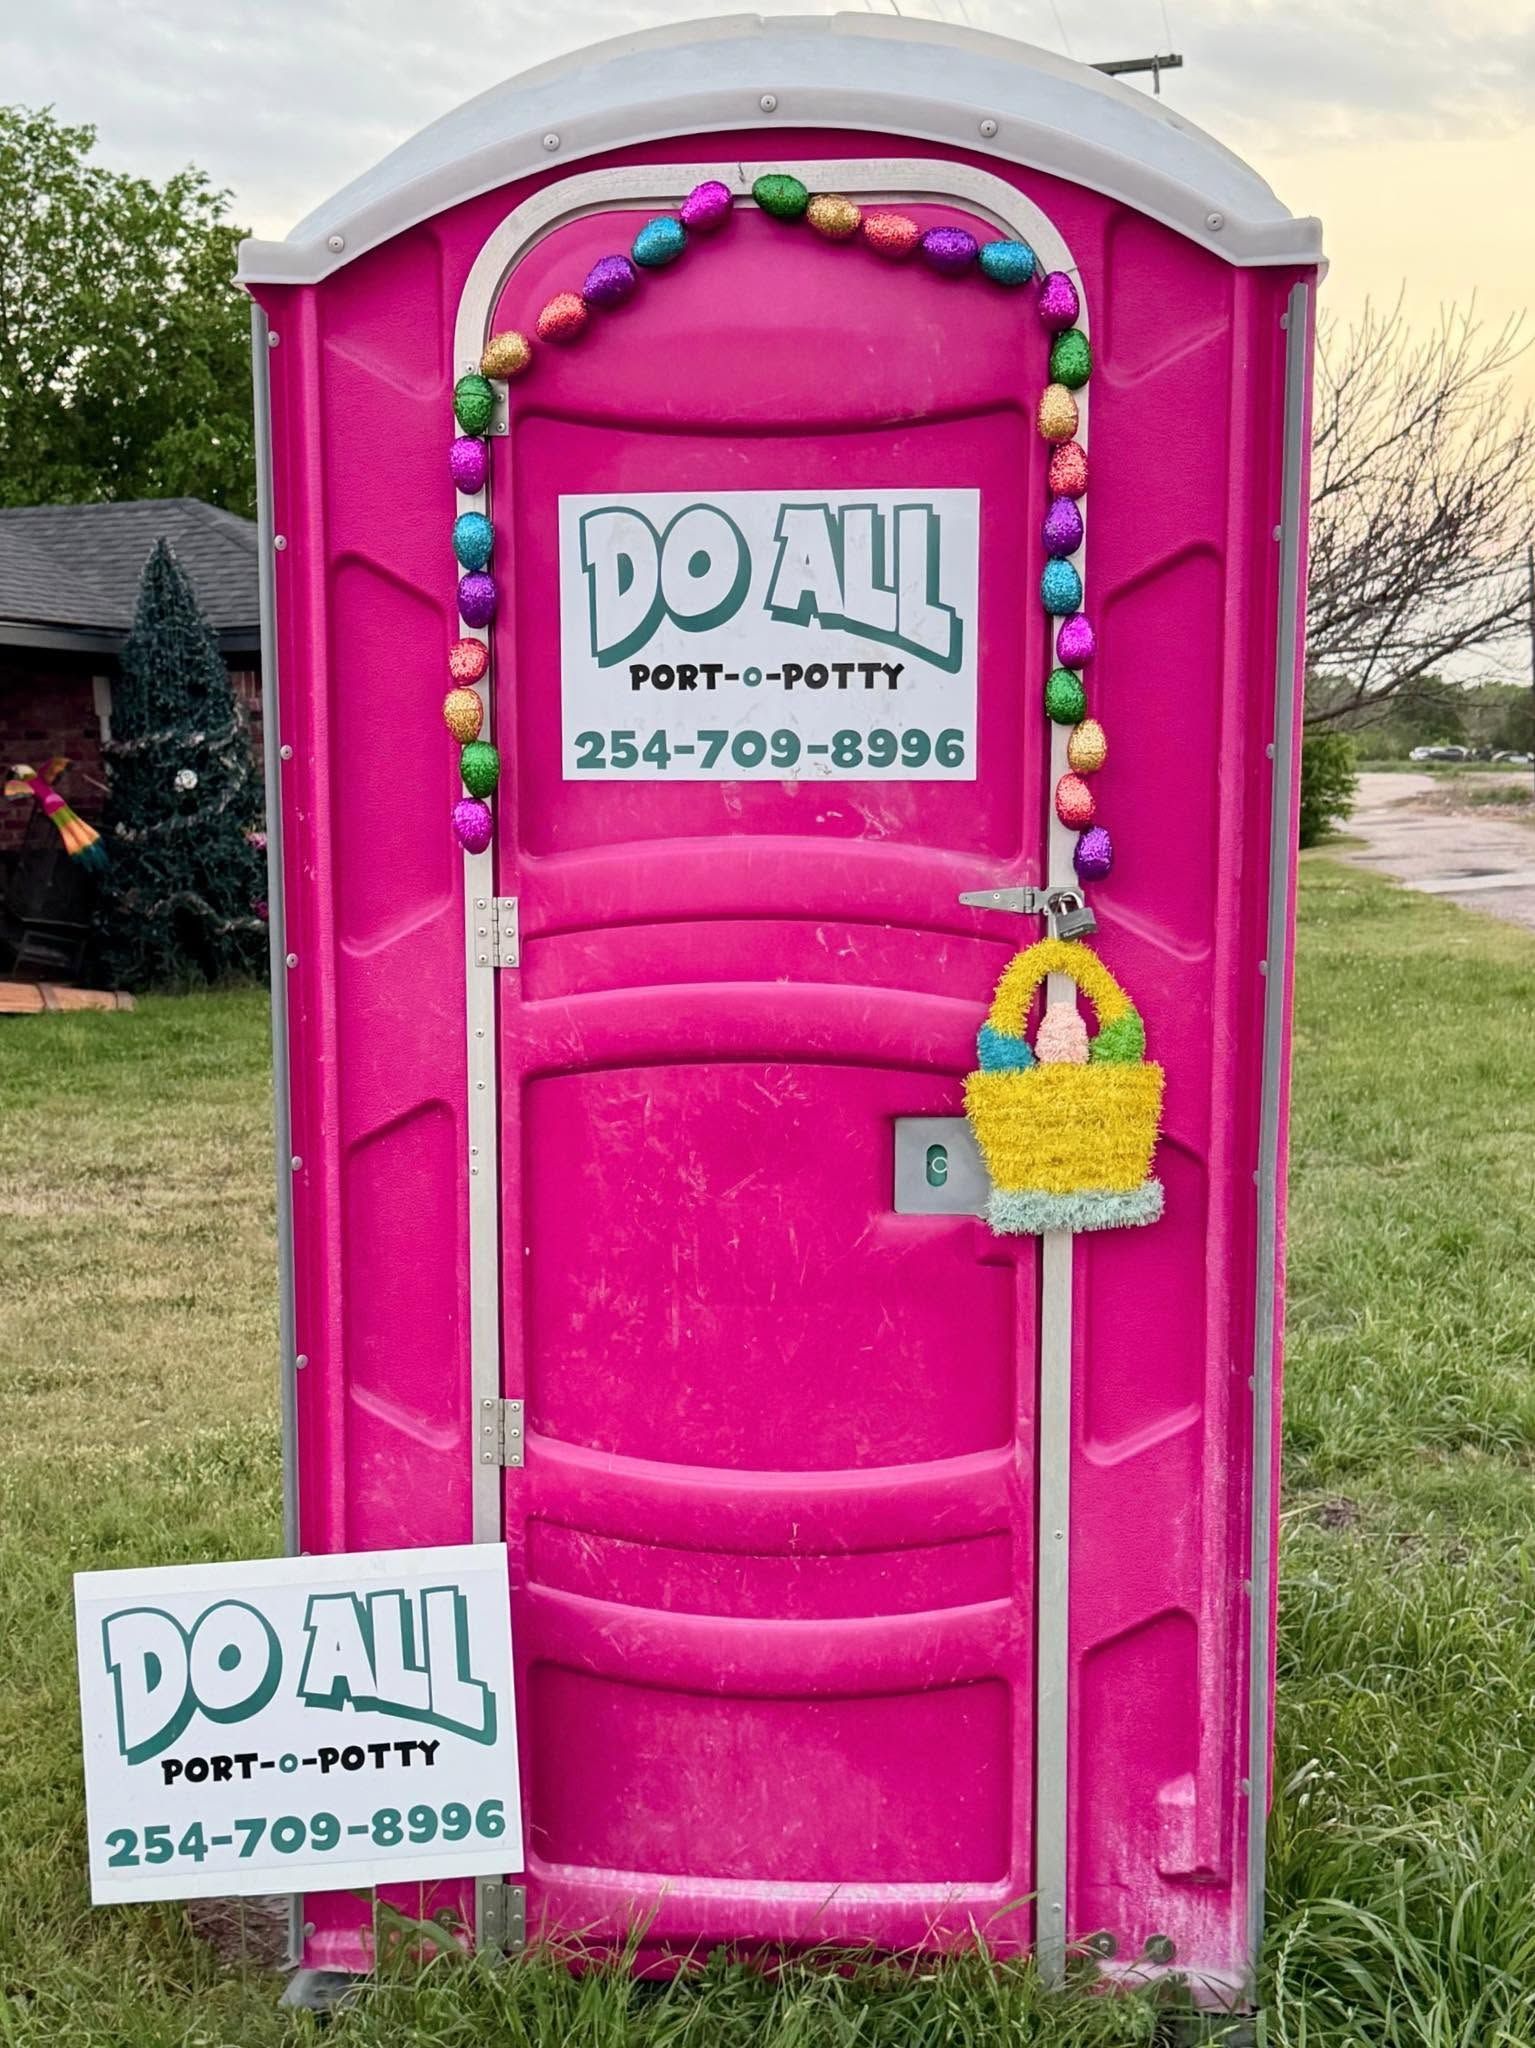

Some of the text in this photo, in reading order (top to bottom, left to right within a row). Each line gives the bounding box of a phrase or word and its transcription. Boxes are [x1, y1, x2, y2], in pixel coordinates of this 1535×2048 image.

[579, 503, 963, 674] DO ALL
[574, 728, 965, 770] 254-709-8996
[102, 1584, 498, 1766] DO ALL
[104, 1799, 506, 1868] 254-709-8996
